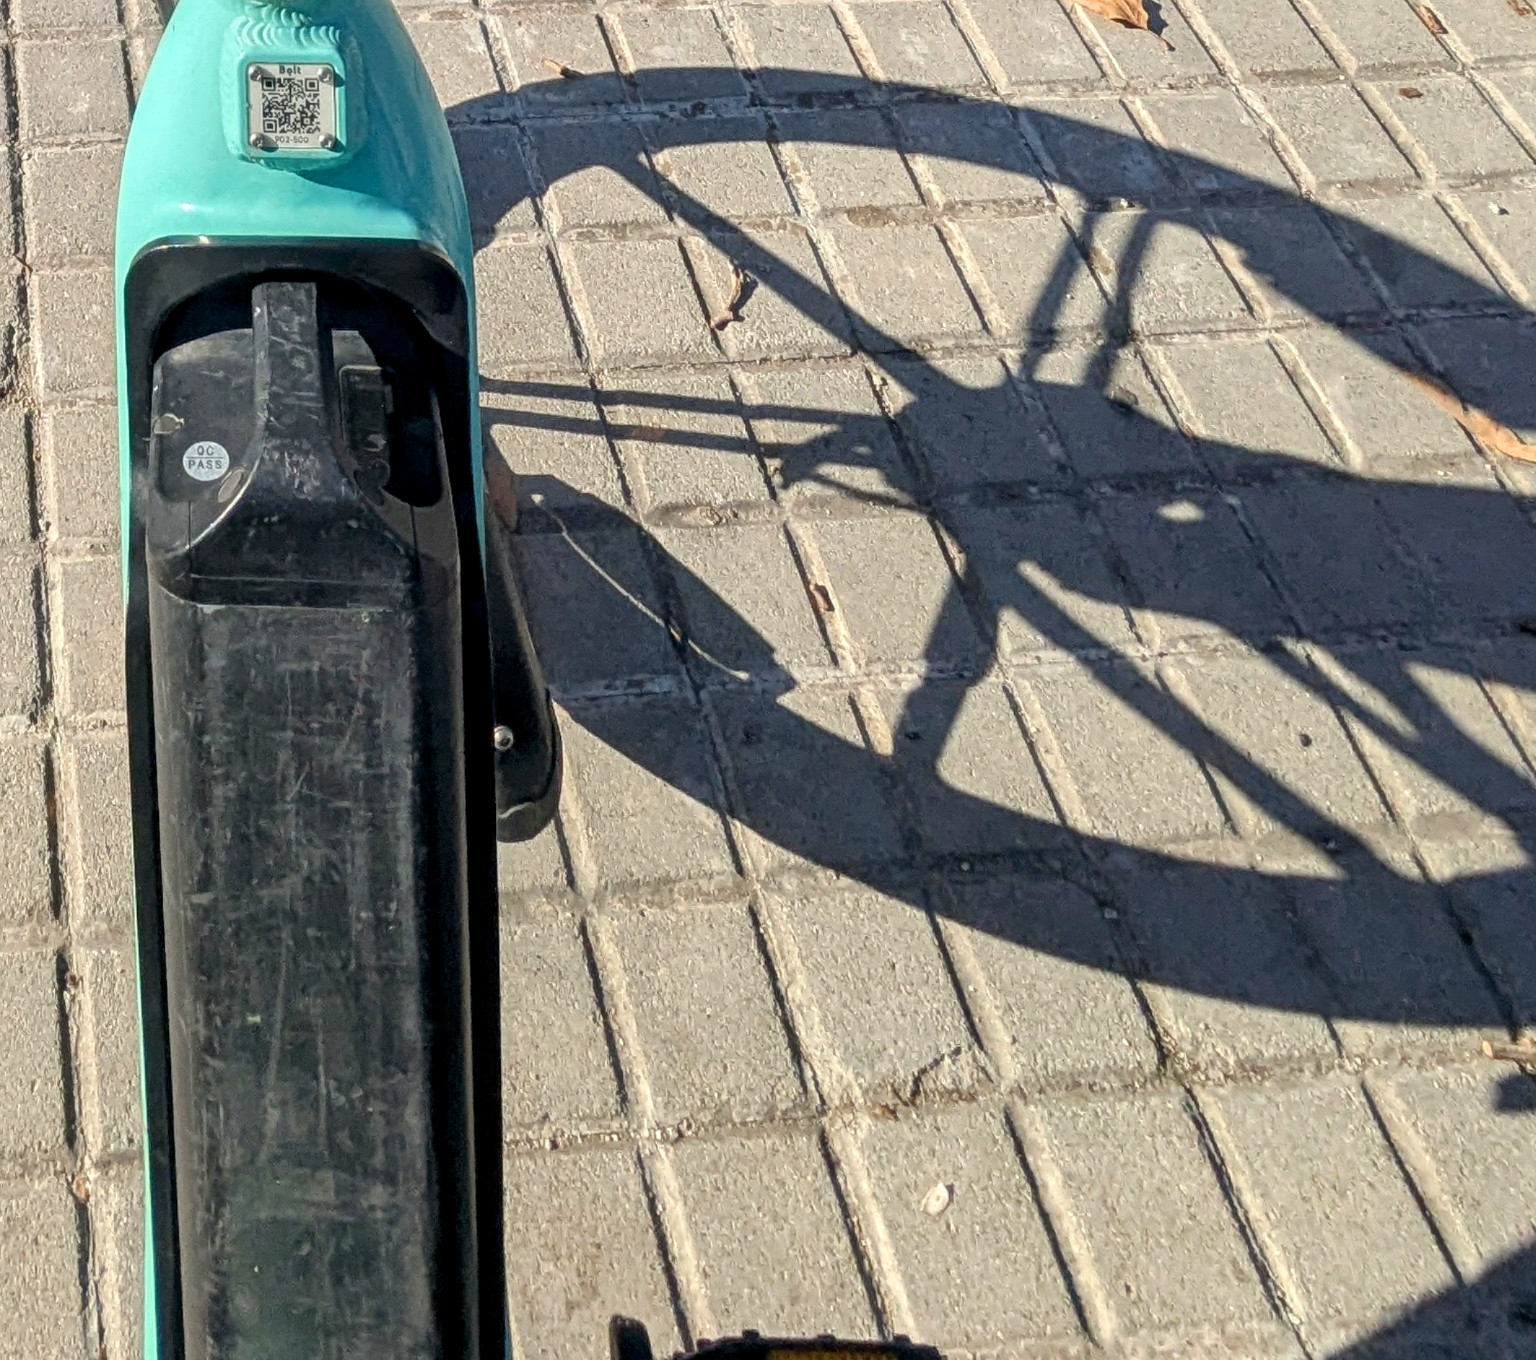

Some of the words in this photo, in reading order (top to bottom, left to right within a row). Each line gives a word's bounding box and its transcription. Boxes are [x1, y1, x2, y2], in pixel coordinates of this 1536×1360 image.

[279, 64, 302, 76] Bolt
[275, 135, 310, 144] 902-500
[196, 445, 214, 456] QC
[188, 459, 222, 470] PASS
